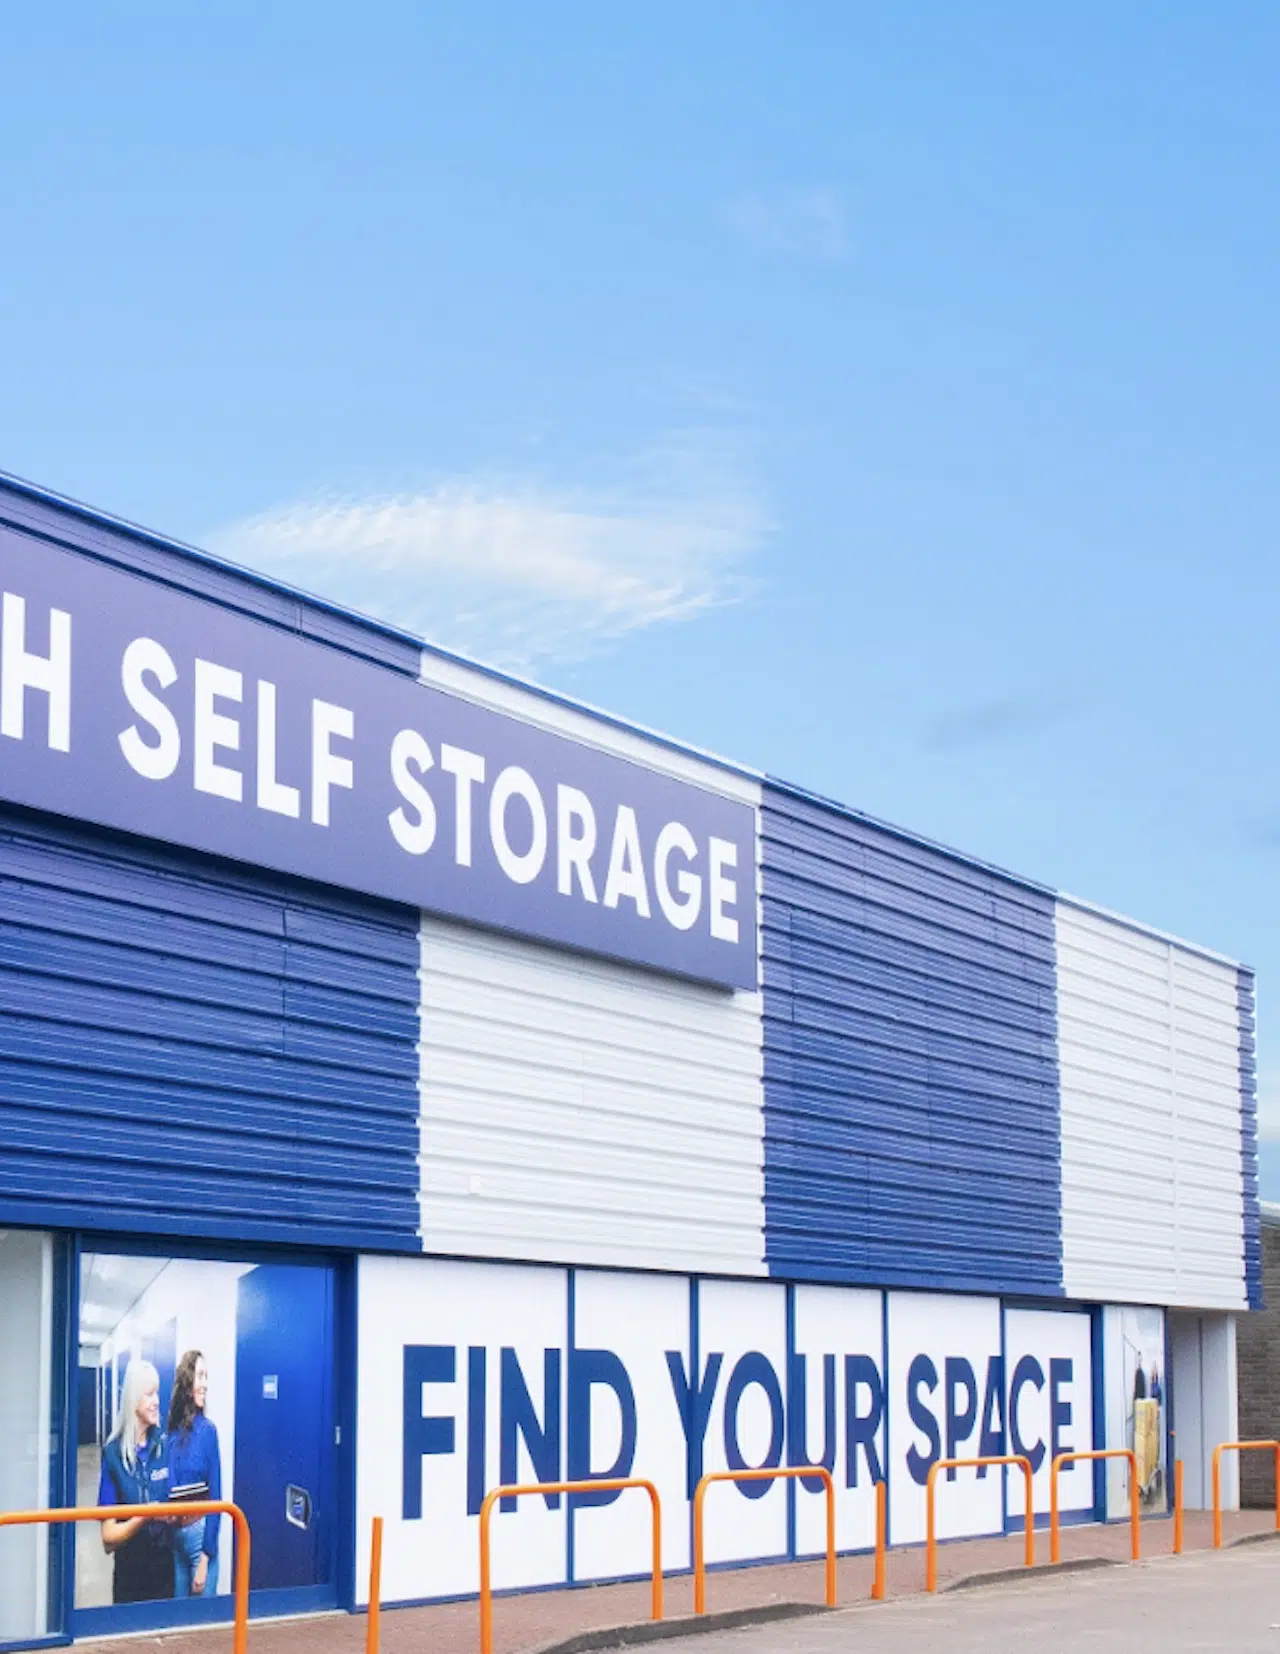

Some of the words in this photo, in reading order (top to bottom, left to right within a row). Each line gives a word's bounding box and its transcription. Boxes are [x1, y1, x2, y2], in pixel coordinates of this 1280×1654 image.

[118, 637, 355, 826] SELF
[387, 728, 740, 944] STORAGE
[402, 1344, 638, 1520] FIND
[664, 1350, 886, 1502] YOUR
[906, 1353, 1074, 1486] SPACE
